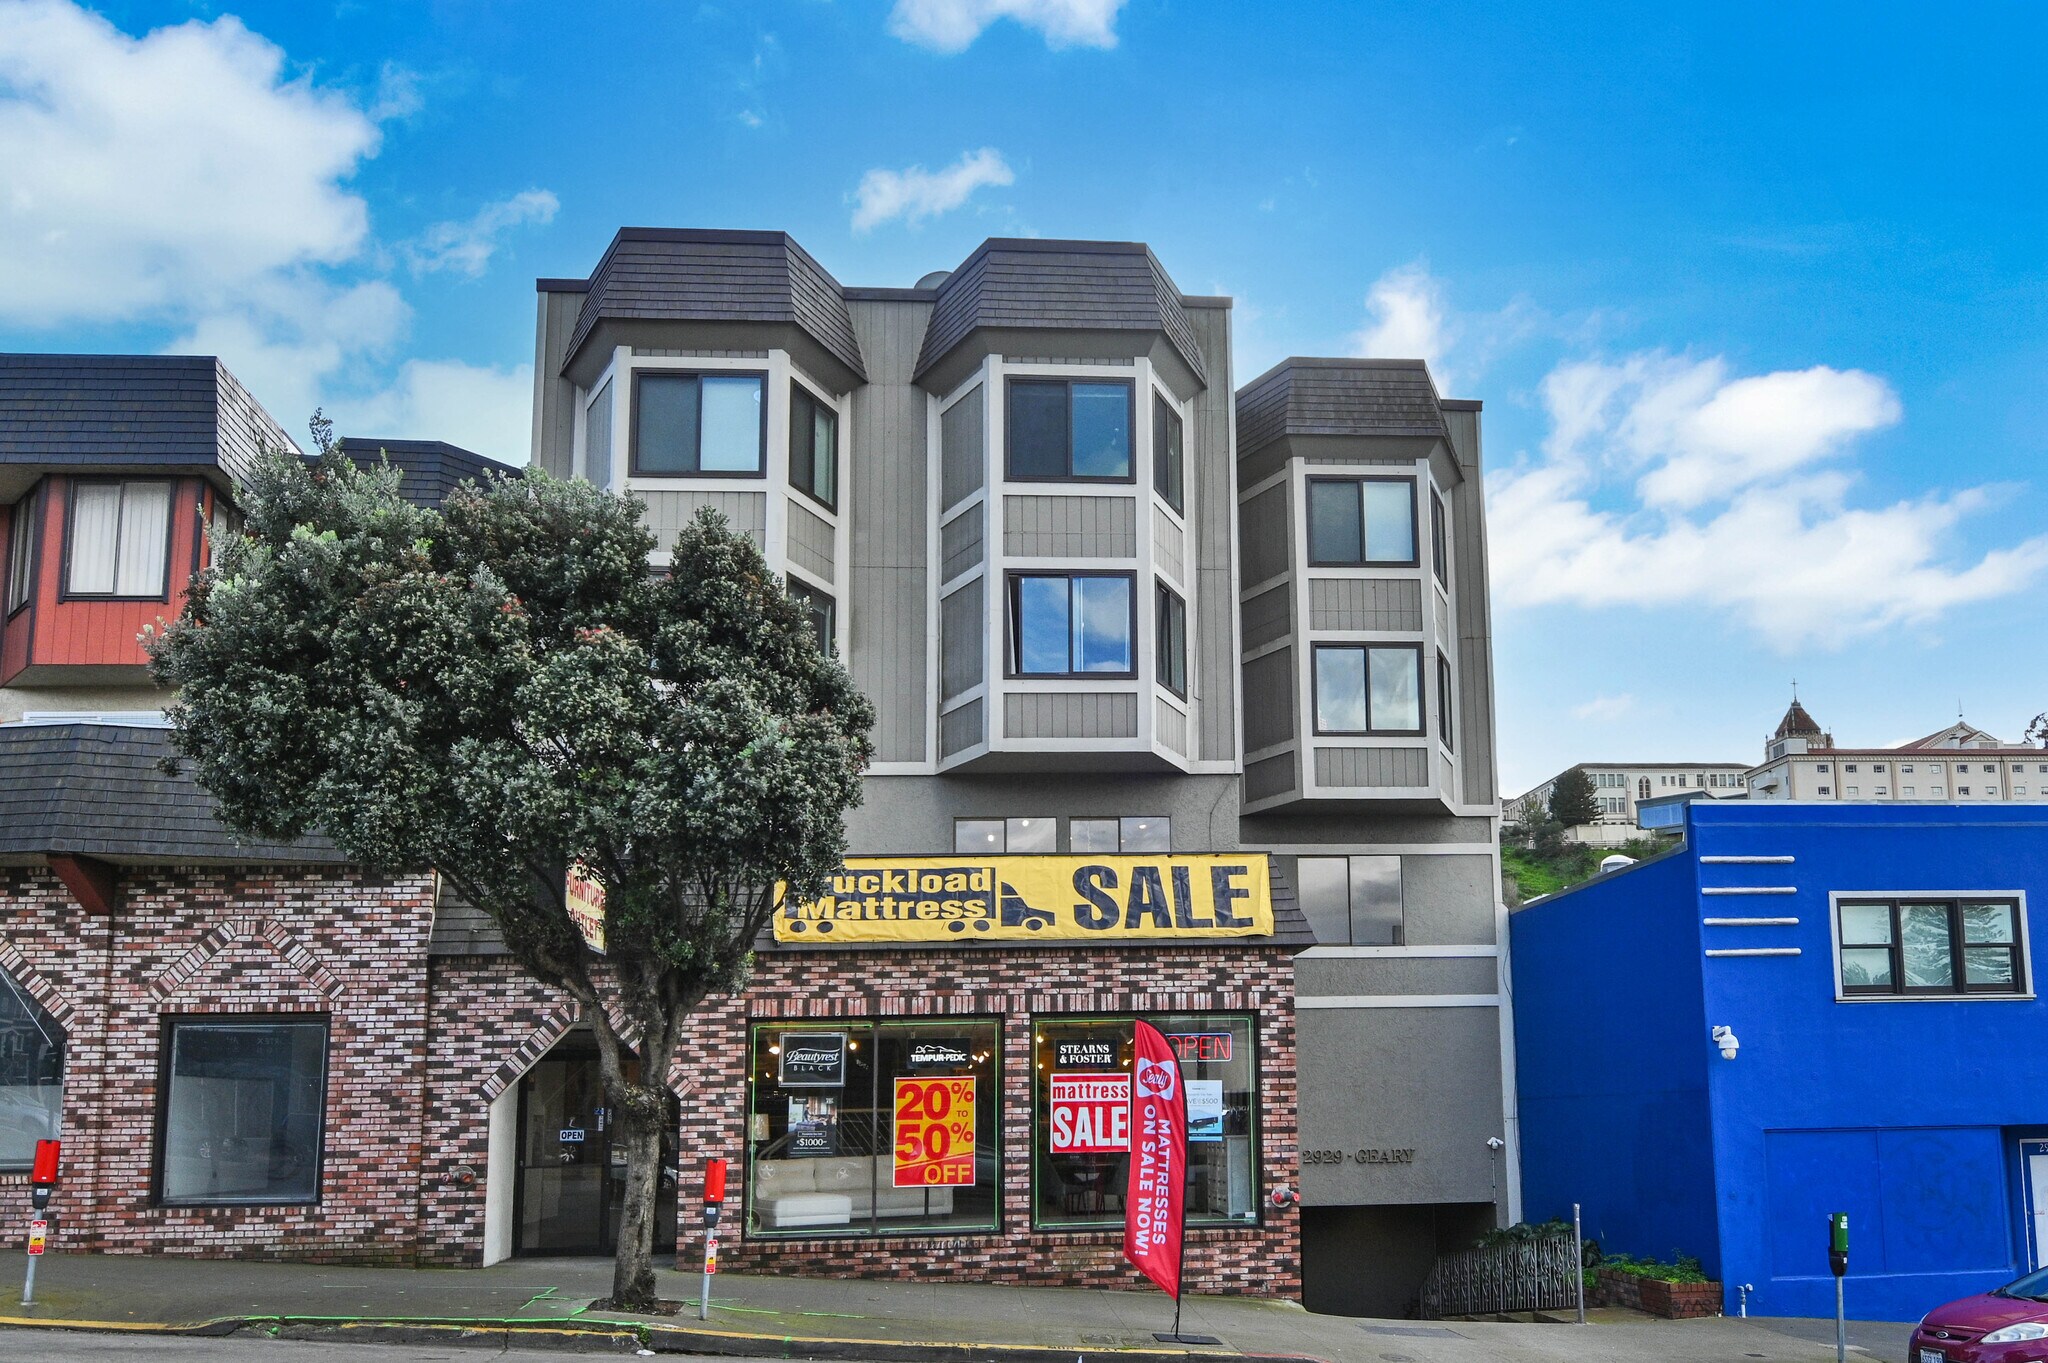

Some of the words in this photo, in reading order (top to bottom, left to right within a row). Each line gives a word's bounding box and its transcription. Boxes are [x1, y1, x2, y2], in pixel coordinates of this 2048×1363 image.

[798, 895, 987, 920] Mattress
[1072, 865, 1254, 930] SALE
[786, 1050, 840, 1063] Beautyrest
[910, 1053, 967, 1062] TEMPUR-PEDIC
[1060, 1044, 1110, 1054] STEARNS
[1168, 1035, 1231, 1059] OPEN
[1059, 1055, 1068, 1064] &
[1070, 1054, 1112, 1064] FOSTER
[1142, 1068, 1168, 1089] Sealy
[895, 1082, 974, 1121] 20%
[1053, 1083, 1129, 1099] mattress
[956, 1110, 969, 1118] TO
[1143, 1104, 1156, 1135] ON
[561, 1131, 584, 1140] OPEN
[1053, 1106, 1128, 1148] SALE
[895, 1122, 975, 1161] 50%
[1139, 1140, 1156, 1192] SALE
[1302, 1149, 1344, 1164] 2929
[1355, 1148, 1415, 1164] GEARY
[924, 1164, 971, 1184] OFF
[1152, 1118, 1172, 1245] MATTRESSES
[1135, 1197, 1151, 1256] NOW!
